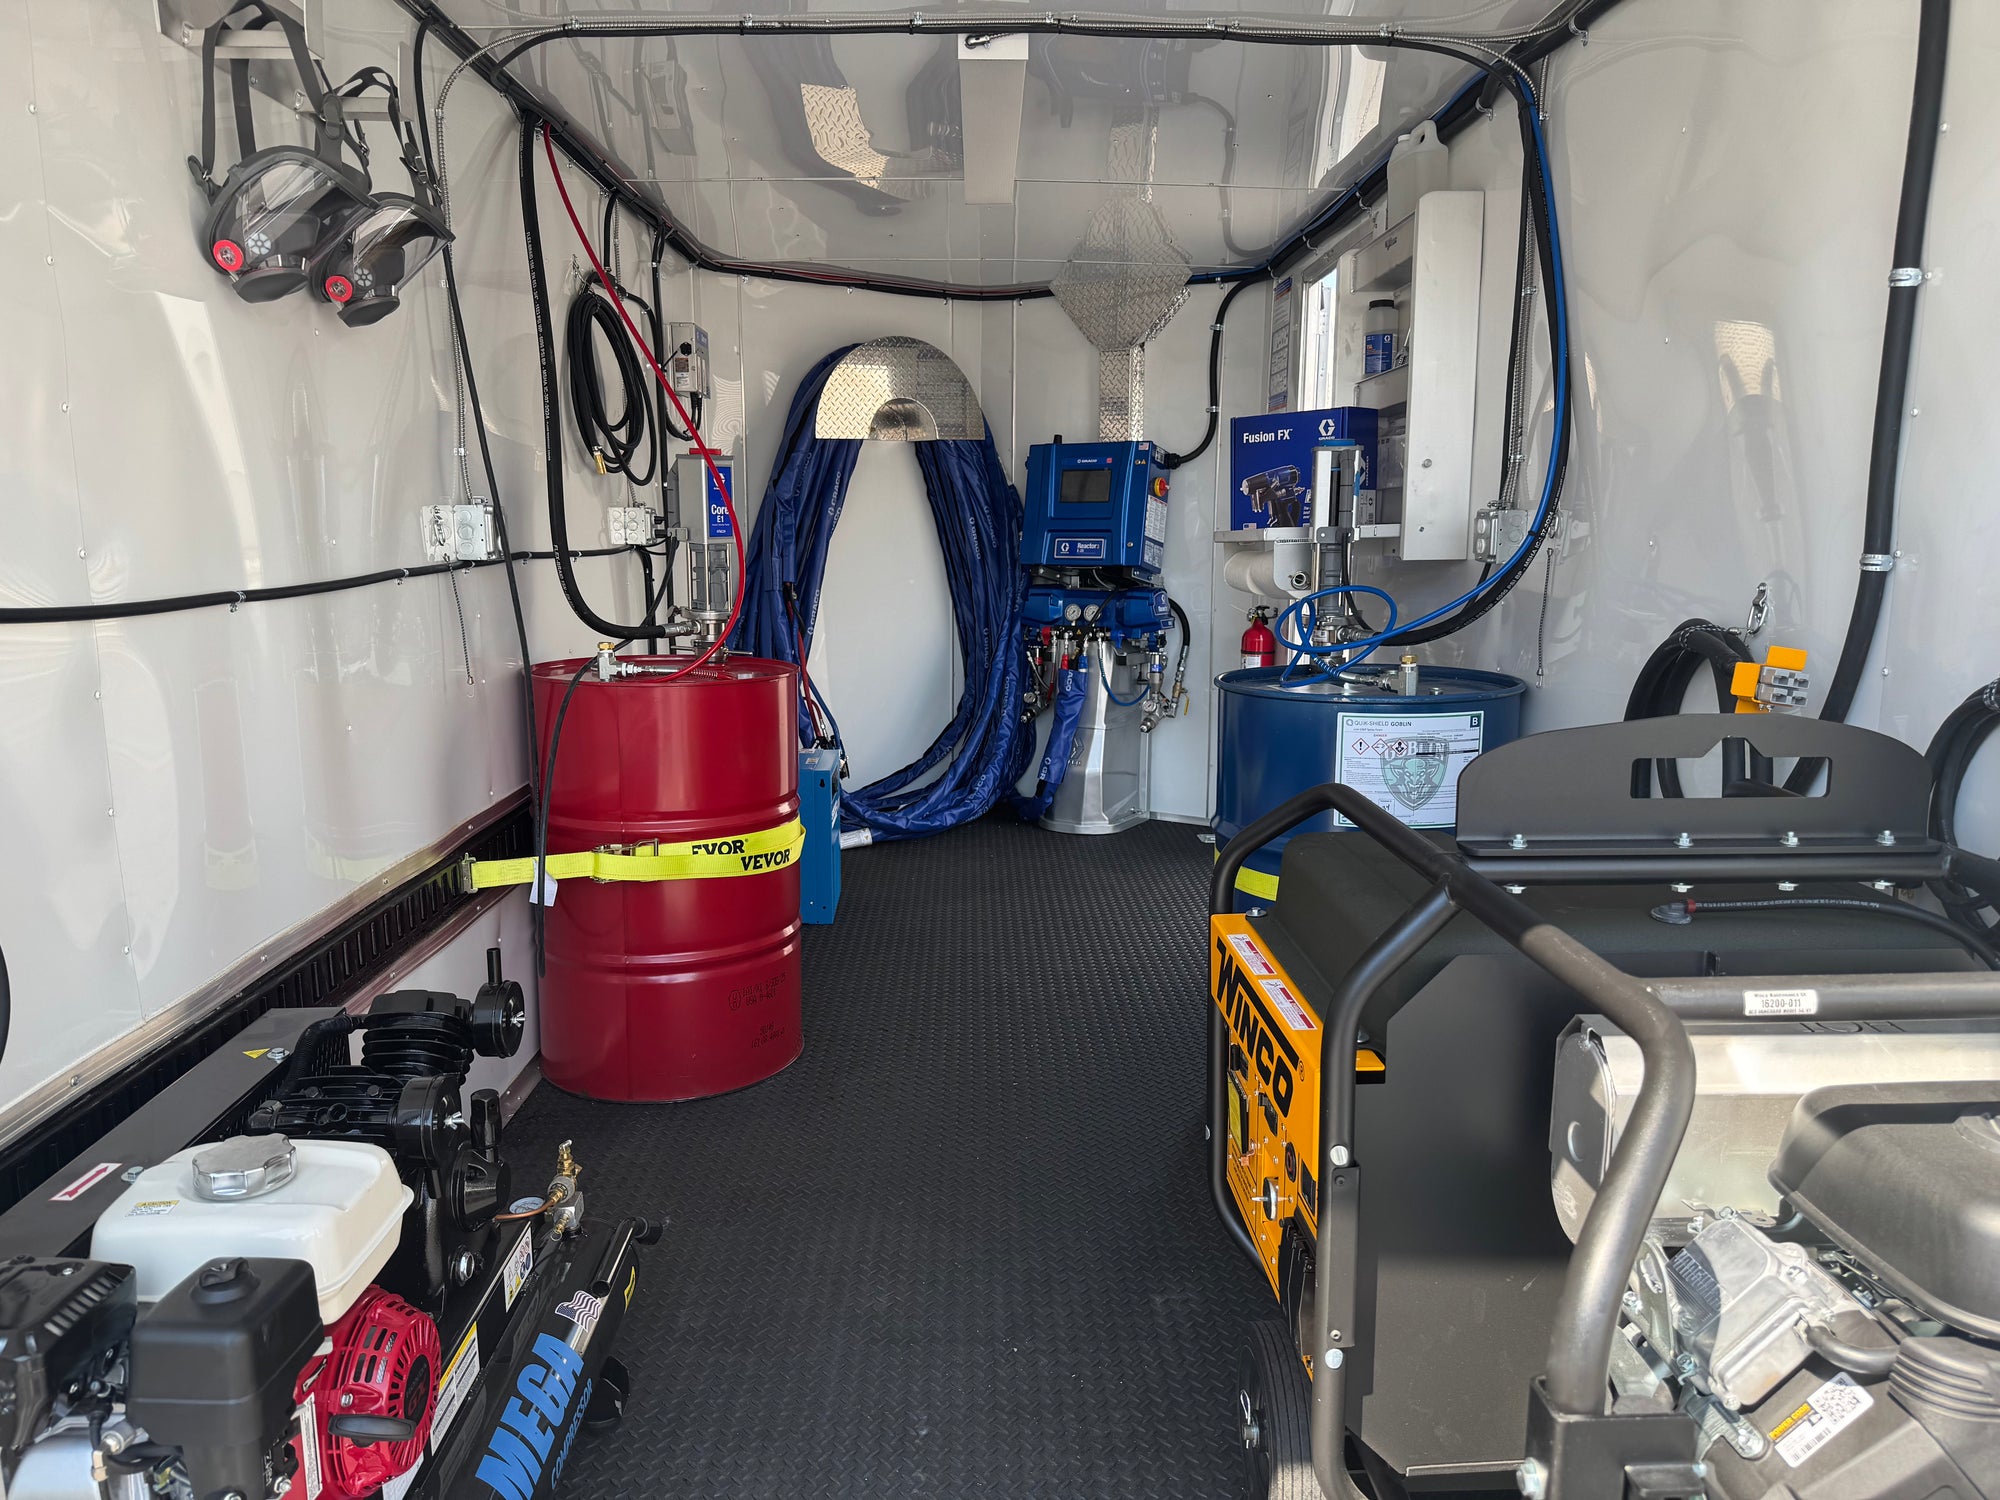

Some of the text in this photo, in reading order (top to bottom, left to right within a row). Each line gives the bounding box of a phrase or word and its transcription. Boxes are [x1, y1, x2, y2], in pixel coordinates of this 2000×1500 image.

[1243, 429, 1290, 443] Fusion FX
[711, 504, 730, 515] Core
[716, 515, 724, 523] E1
[971, 526, 982, 560] GRACO
[1523, 549, 1538, 568] MSHA
[810, 588, 820, 626] GRACO
[1471, 717, 1479, 726] B
[741, 848, 791, 871] VEVOR
[1761, 999, 1801, 1008] 16200-011
[1216, 935, 1300, 1118] WINCO
[475, 1332, 585, 1500] MEGA
[551, 1377, 593, 1490] COMPRESSOR
